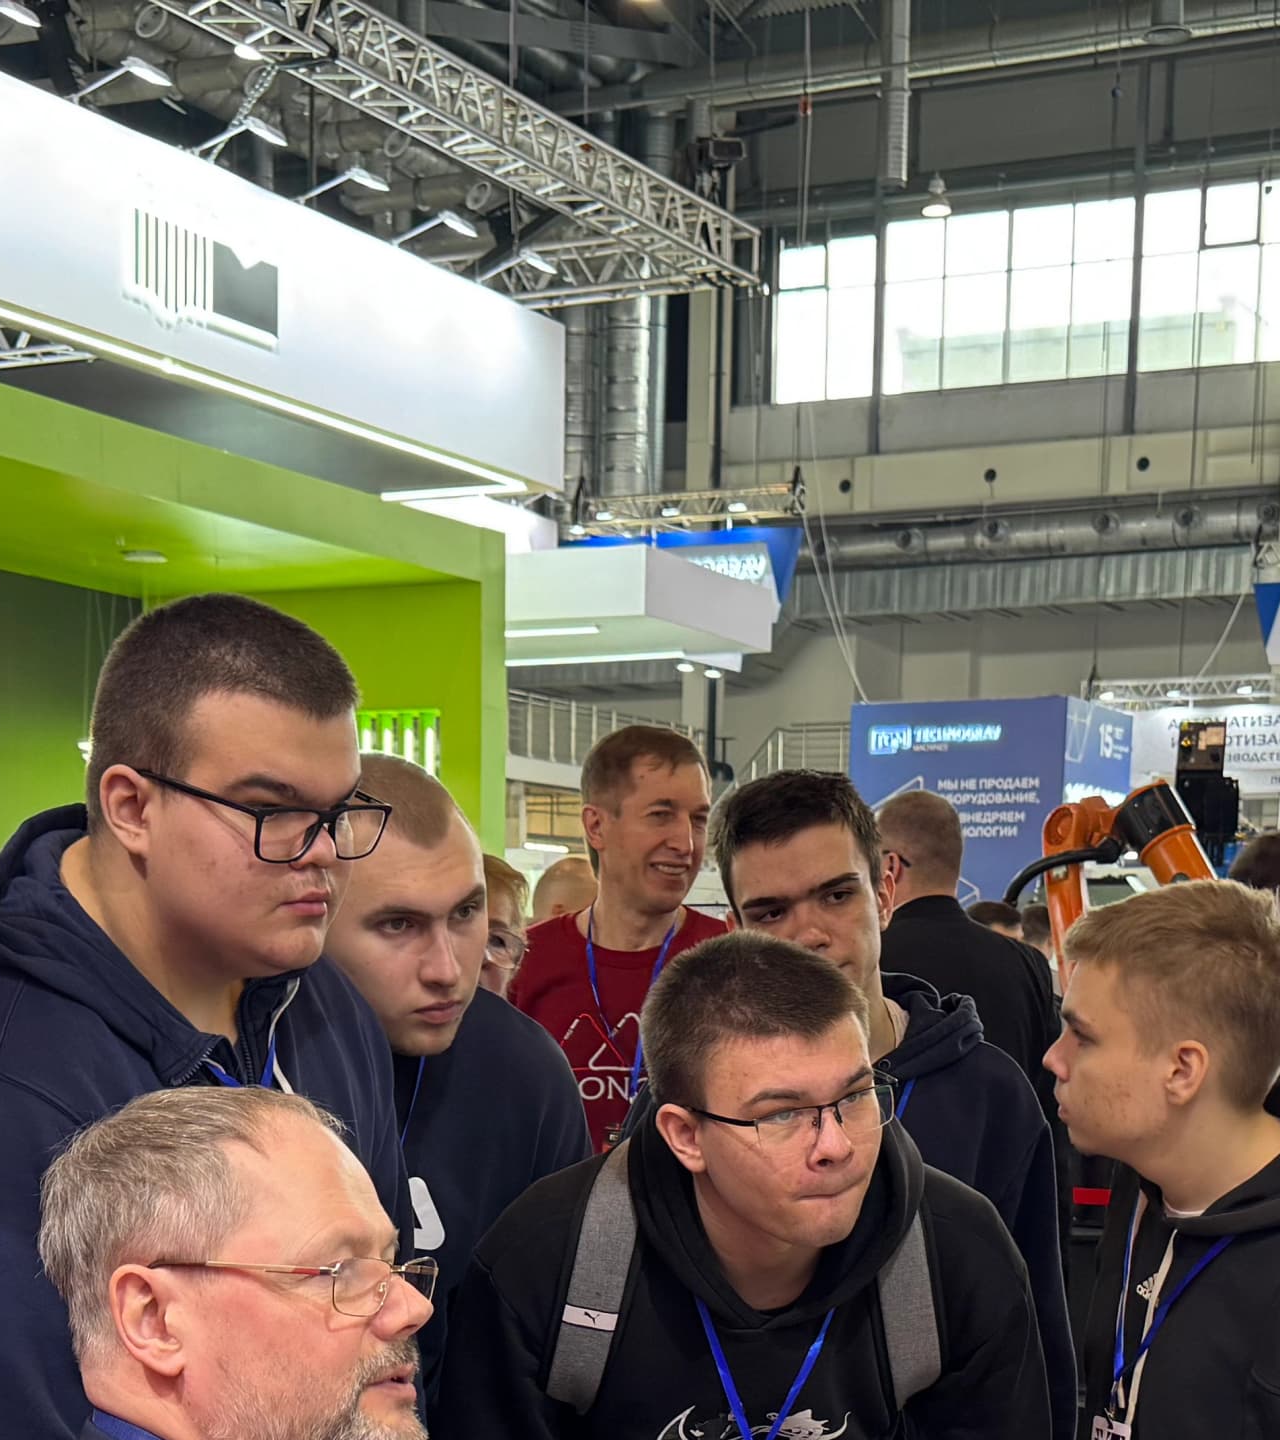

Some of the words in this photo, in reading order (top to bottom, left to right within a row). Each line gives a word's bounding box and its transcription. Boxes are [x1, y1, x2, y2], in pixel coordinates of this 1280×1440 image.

[938, 780, 958, 791] МЫ
[960, 780, 977, 790] НЕ
[980, 777, 1039, 790] ПРОДАЕМ
